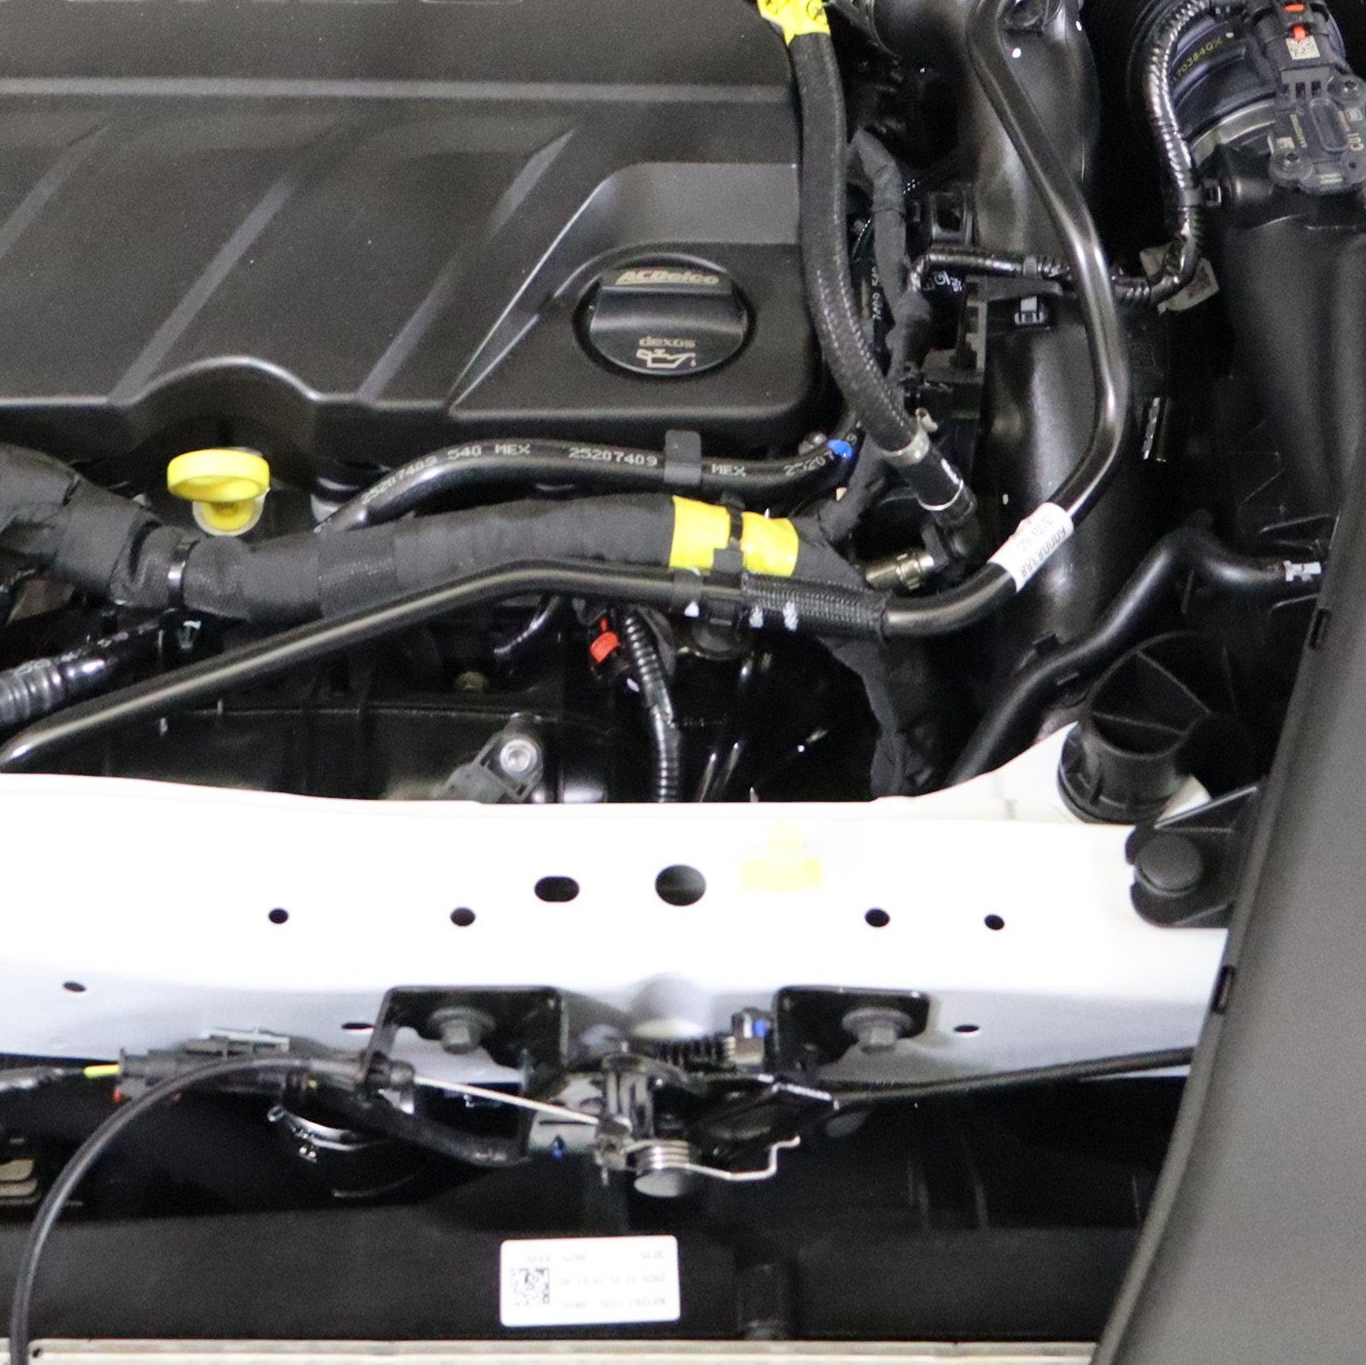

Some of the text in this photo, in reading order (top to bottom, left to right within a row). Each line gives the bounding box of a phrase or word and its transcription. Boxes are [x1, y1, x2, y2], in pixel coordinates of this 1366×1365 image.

[615, 270, 720, 286] ACDelco
[639, 336, 696, 348] dexos
[362, 455, 439, 504] 25207409
[447, 445, 483, 460] 540
[494, 443, 531, 456] MEX
[568, 446, 659, 468] 25207409
[711, 462, 747, 477] MEX
